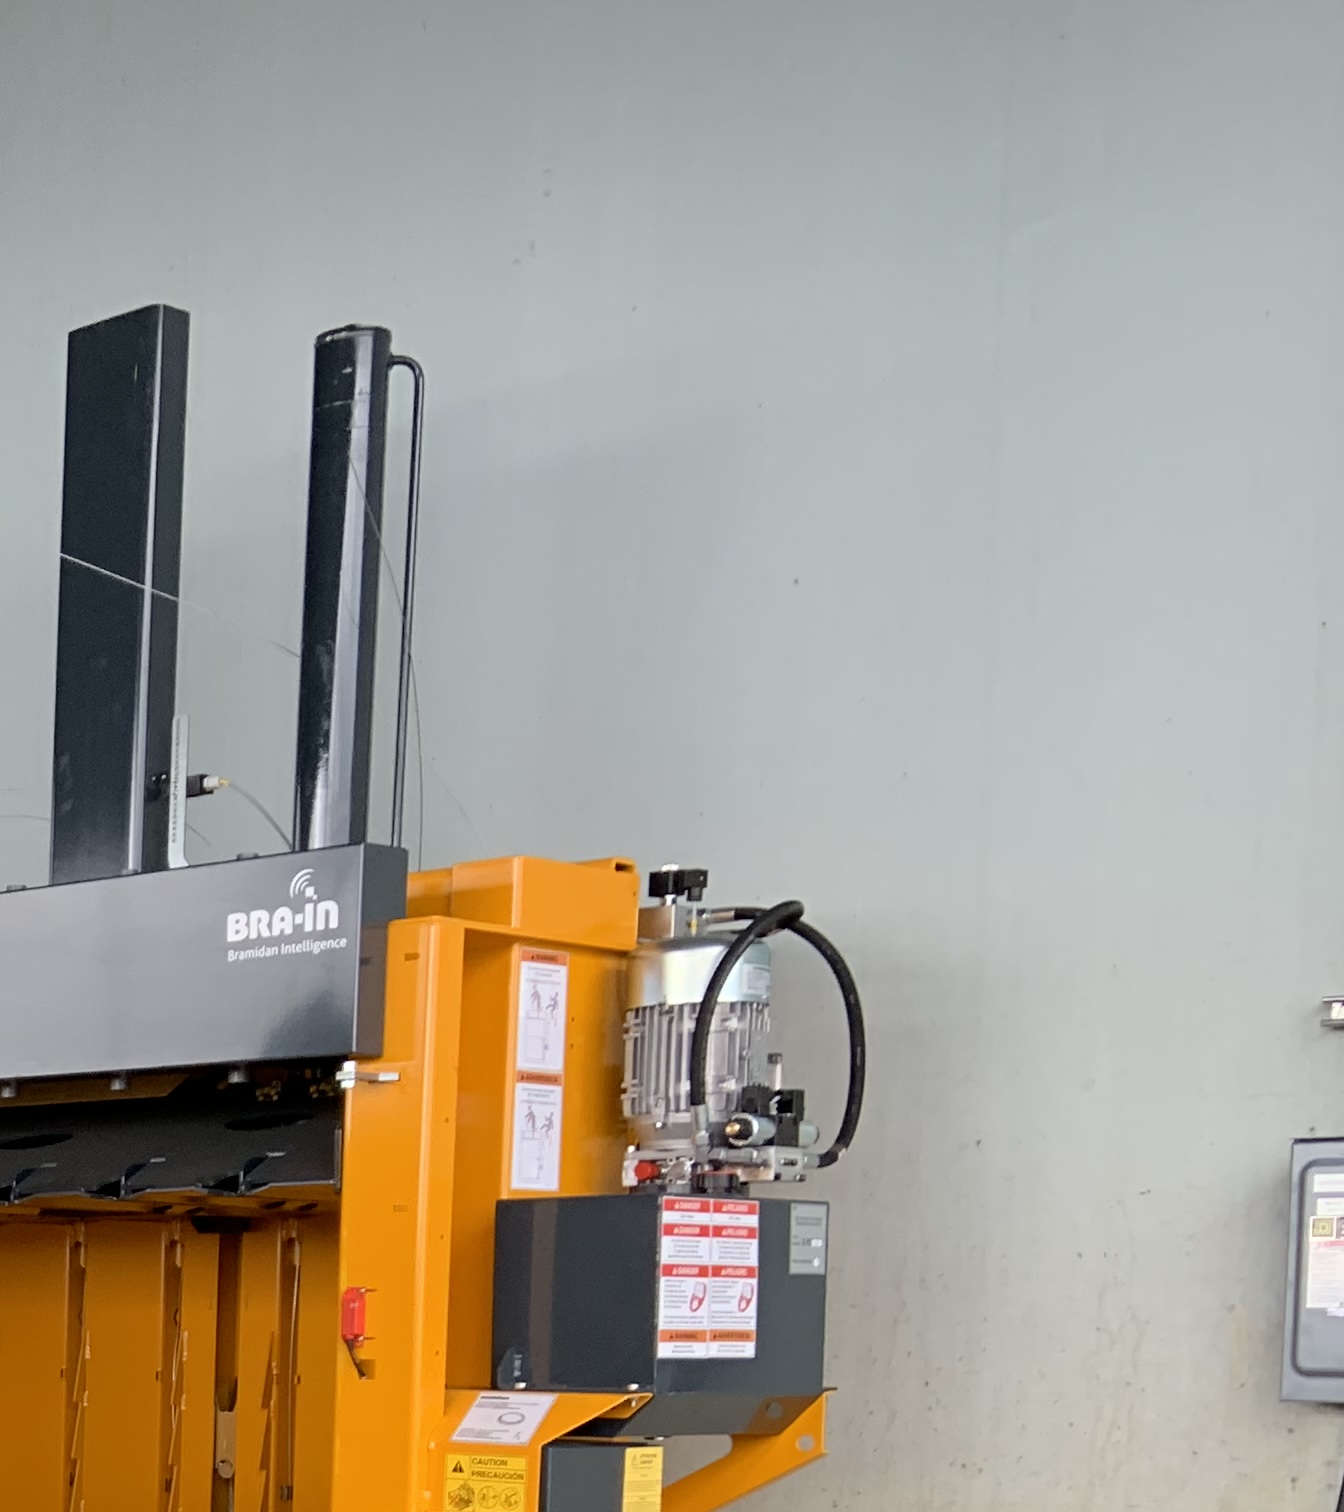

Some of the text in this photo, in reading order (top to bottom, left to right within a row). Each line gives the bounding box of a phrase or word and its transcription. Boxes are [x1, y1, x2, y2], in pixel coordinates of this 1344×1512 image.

[227, 937, 348, 962] Bramidan Intelligence
[471, 1457, 508, 1467] CAUTION
[470, 1469, 525, 1481] PRECAUCIÓN
